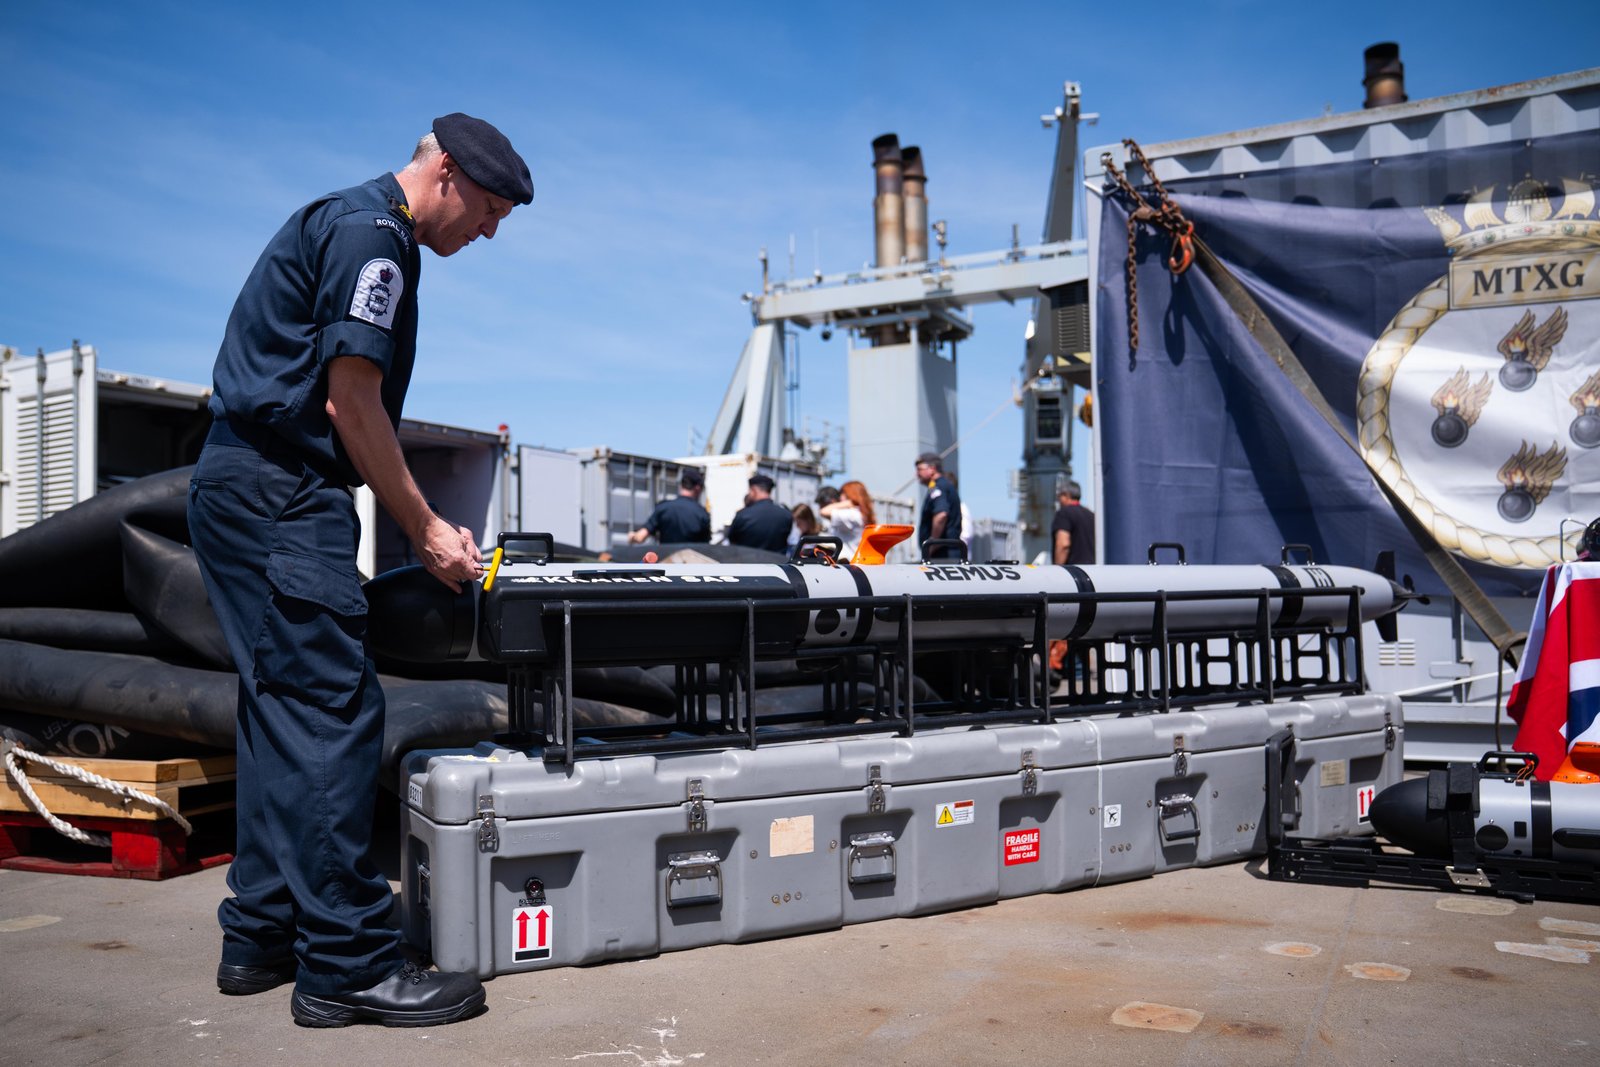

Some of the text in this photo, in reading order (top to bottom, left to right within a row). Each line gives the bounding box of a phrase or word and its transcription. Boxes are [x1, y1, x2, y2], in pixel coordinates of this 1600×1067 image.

[376, 218, 400, 232] ROYAL
[1472, 259, 1585, 296] MTXG
[680, 575, 740, 583] SAS
[924, 565, 1021, 581] REMUS
[1005, 832, 1039, 847] FRAGILE
[1007, 850, 1037, 861] WITH CARE
[1011, 844, 1033, 853] HANDLE
